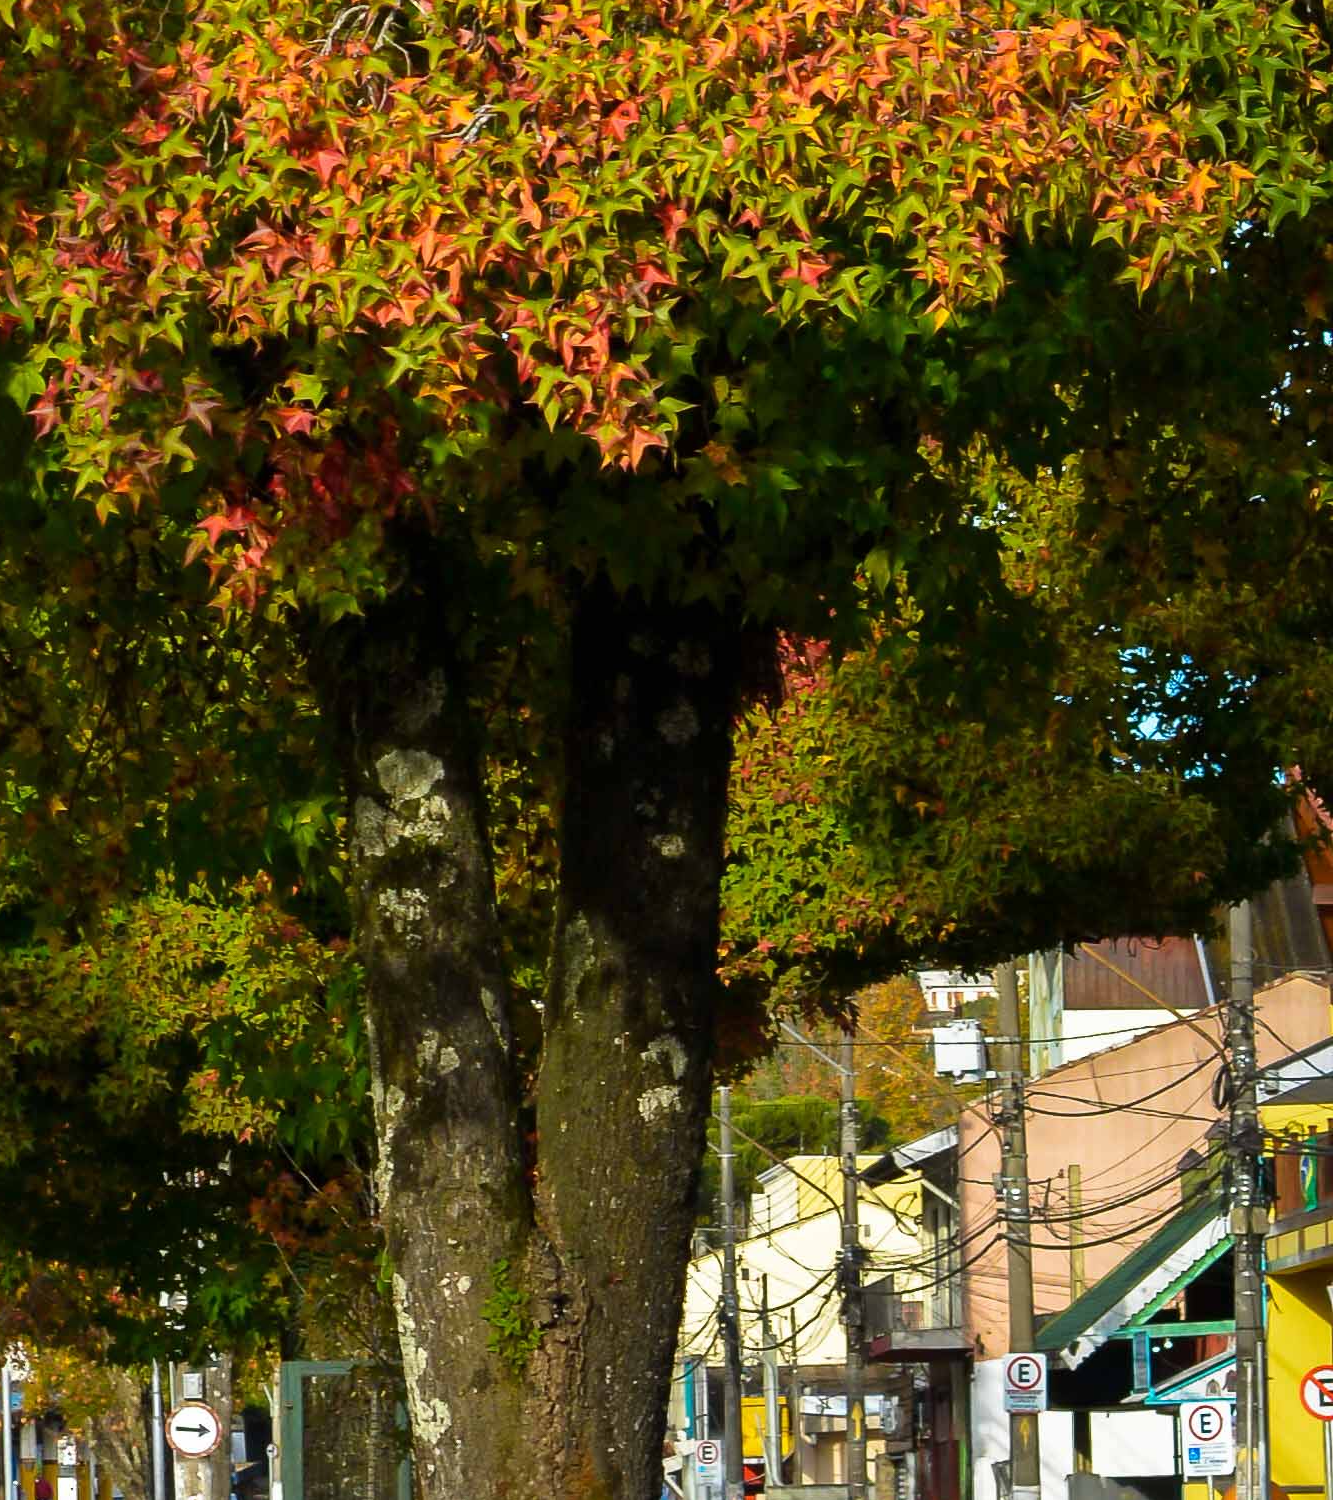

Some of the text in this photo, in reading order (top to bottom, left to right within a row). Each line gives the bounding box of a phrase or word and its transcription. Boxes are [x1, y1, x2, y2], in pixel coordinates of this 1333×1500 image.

[1018, 1364, 1030, 1382] E
[1200, 1413, 1212, 1433] E
[702, 1445, 713, 1460] E
